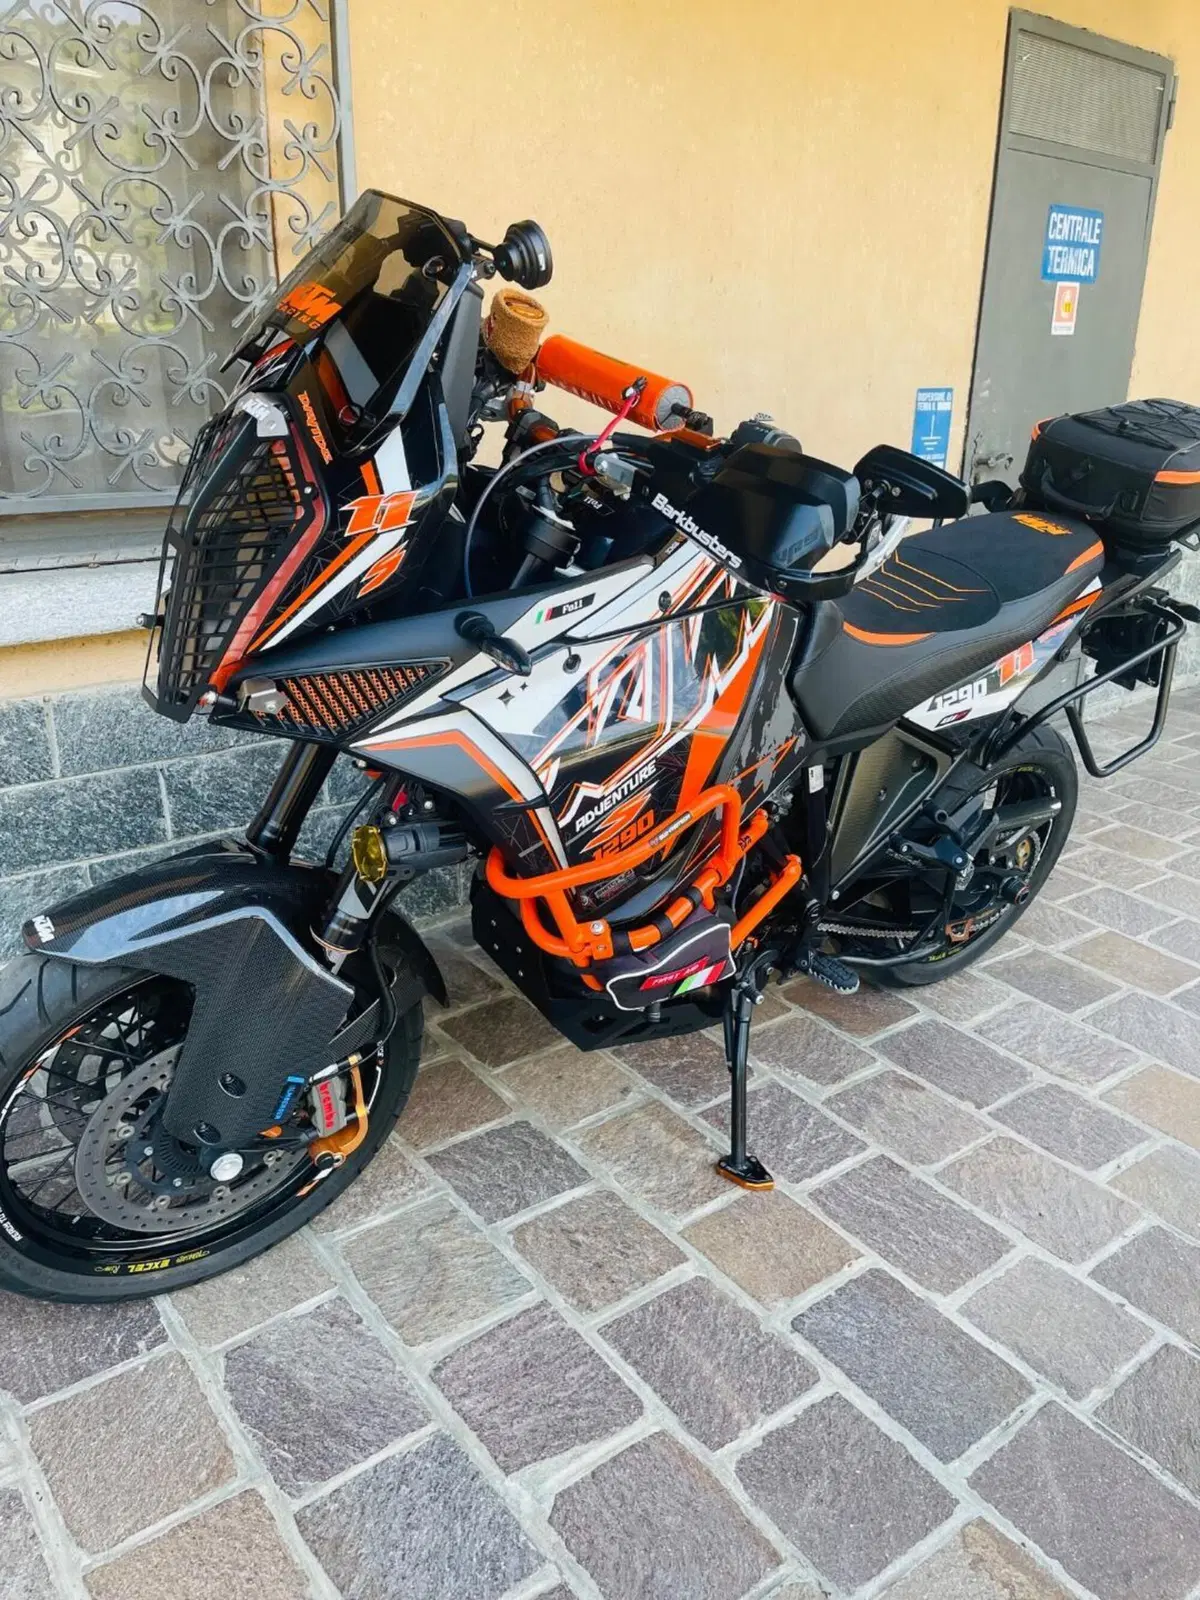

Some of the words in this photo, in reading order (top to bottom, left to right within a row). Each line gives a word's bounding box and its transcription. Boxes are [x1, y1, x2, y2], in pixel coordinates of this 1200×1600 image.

[1048, 212, 1102, 244] CENTRALE
[1047, 245, 1095, 277] TERMICA
[651, 492, 742, 569] Barkbusters
[927, 677, 988, 712] 1290
[575, 759, 657, 833] ADVENTURE
[592, 808, 655, 860] 1290
[31, 914, 56, 943] KTM
[319, 1080, 337, 1129] brembo
[2, 1220, 24, 1242] READY
[127, 1259, 171, 1274] EXCEL
